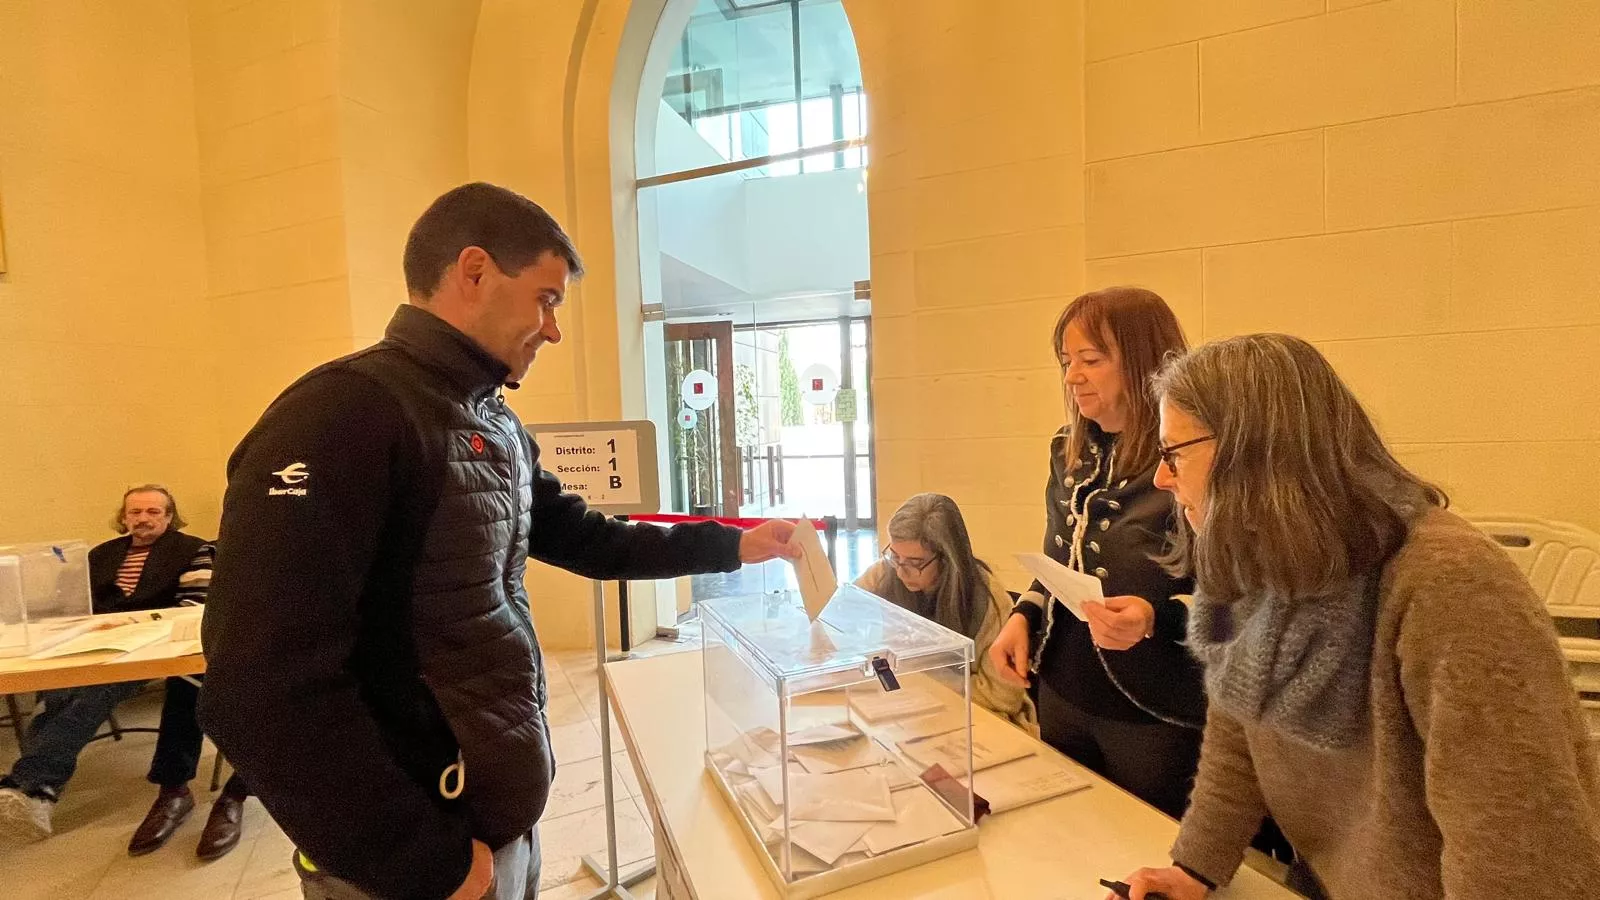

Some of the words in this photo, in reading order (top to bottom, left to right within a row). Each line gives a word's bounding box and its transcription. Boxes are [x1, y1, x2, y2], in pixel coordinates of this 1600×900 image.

[556, 446, 595, 455] Distrito:
[607, 438, 615, 453] 1
[557, 464, 600, 473] Sección:
[608, 457, 617, 471] 1
[609, 475, 622, 489] B
